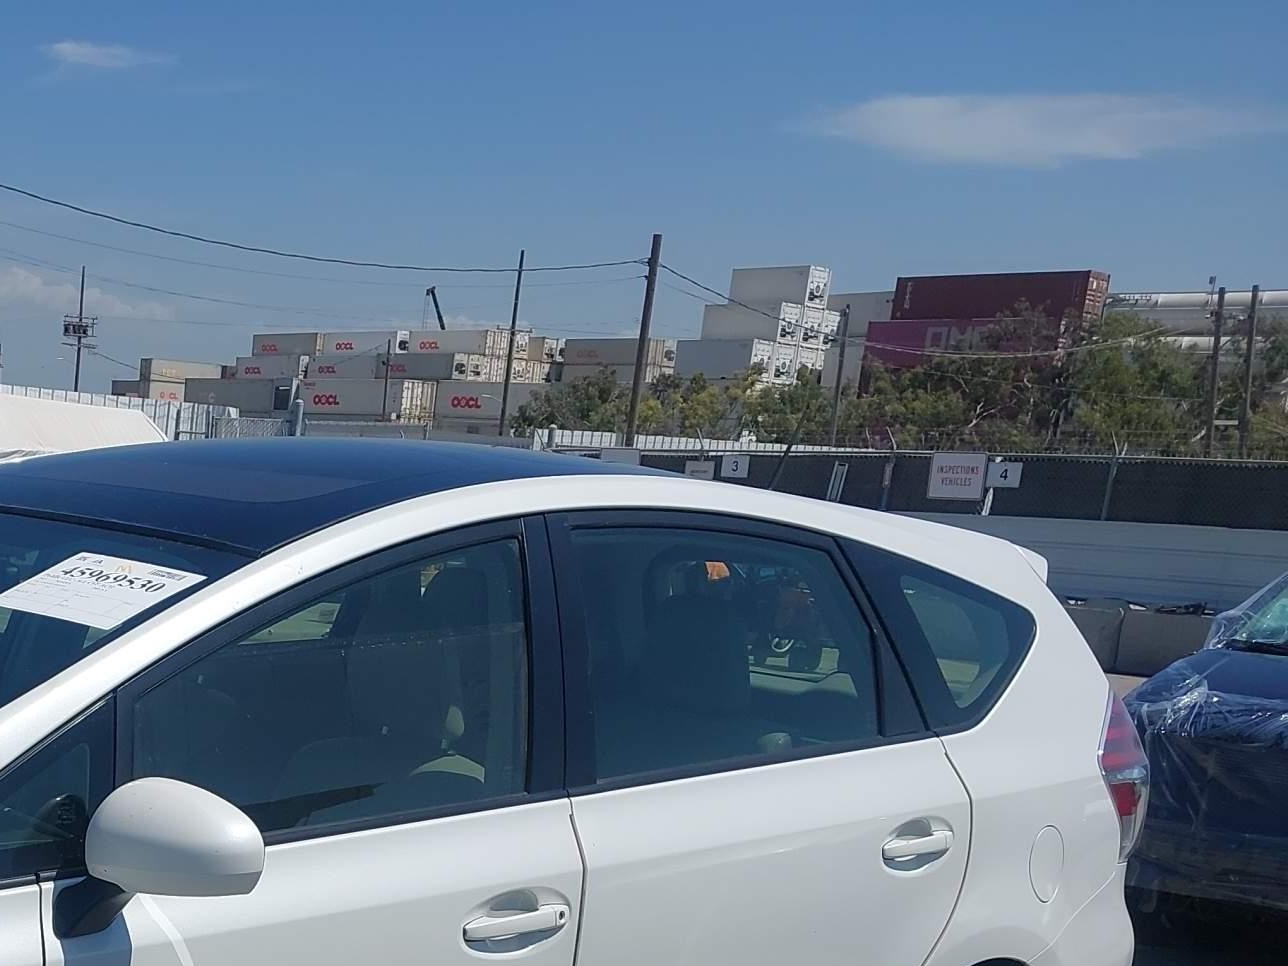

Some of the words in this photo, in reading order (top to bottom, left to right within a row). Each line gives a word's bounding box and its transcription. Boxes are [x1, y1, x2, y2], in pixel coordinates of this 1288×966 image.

[335, 342, 355, 351] OOCL
[419, 341, 440, 350] OOCL
[318, 365, 336, 374] OOCL
[313, 394, 340, 406] OOCL
[451, 396, 482, 409] OOCL
[731, 460, 739, 472] 3
[999, 468, 1009, 481] 4
[61, 566, 167, 593] 45969530
